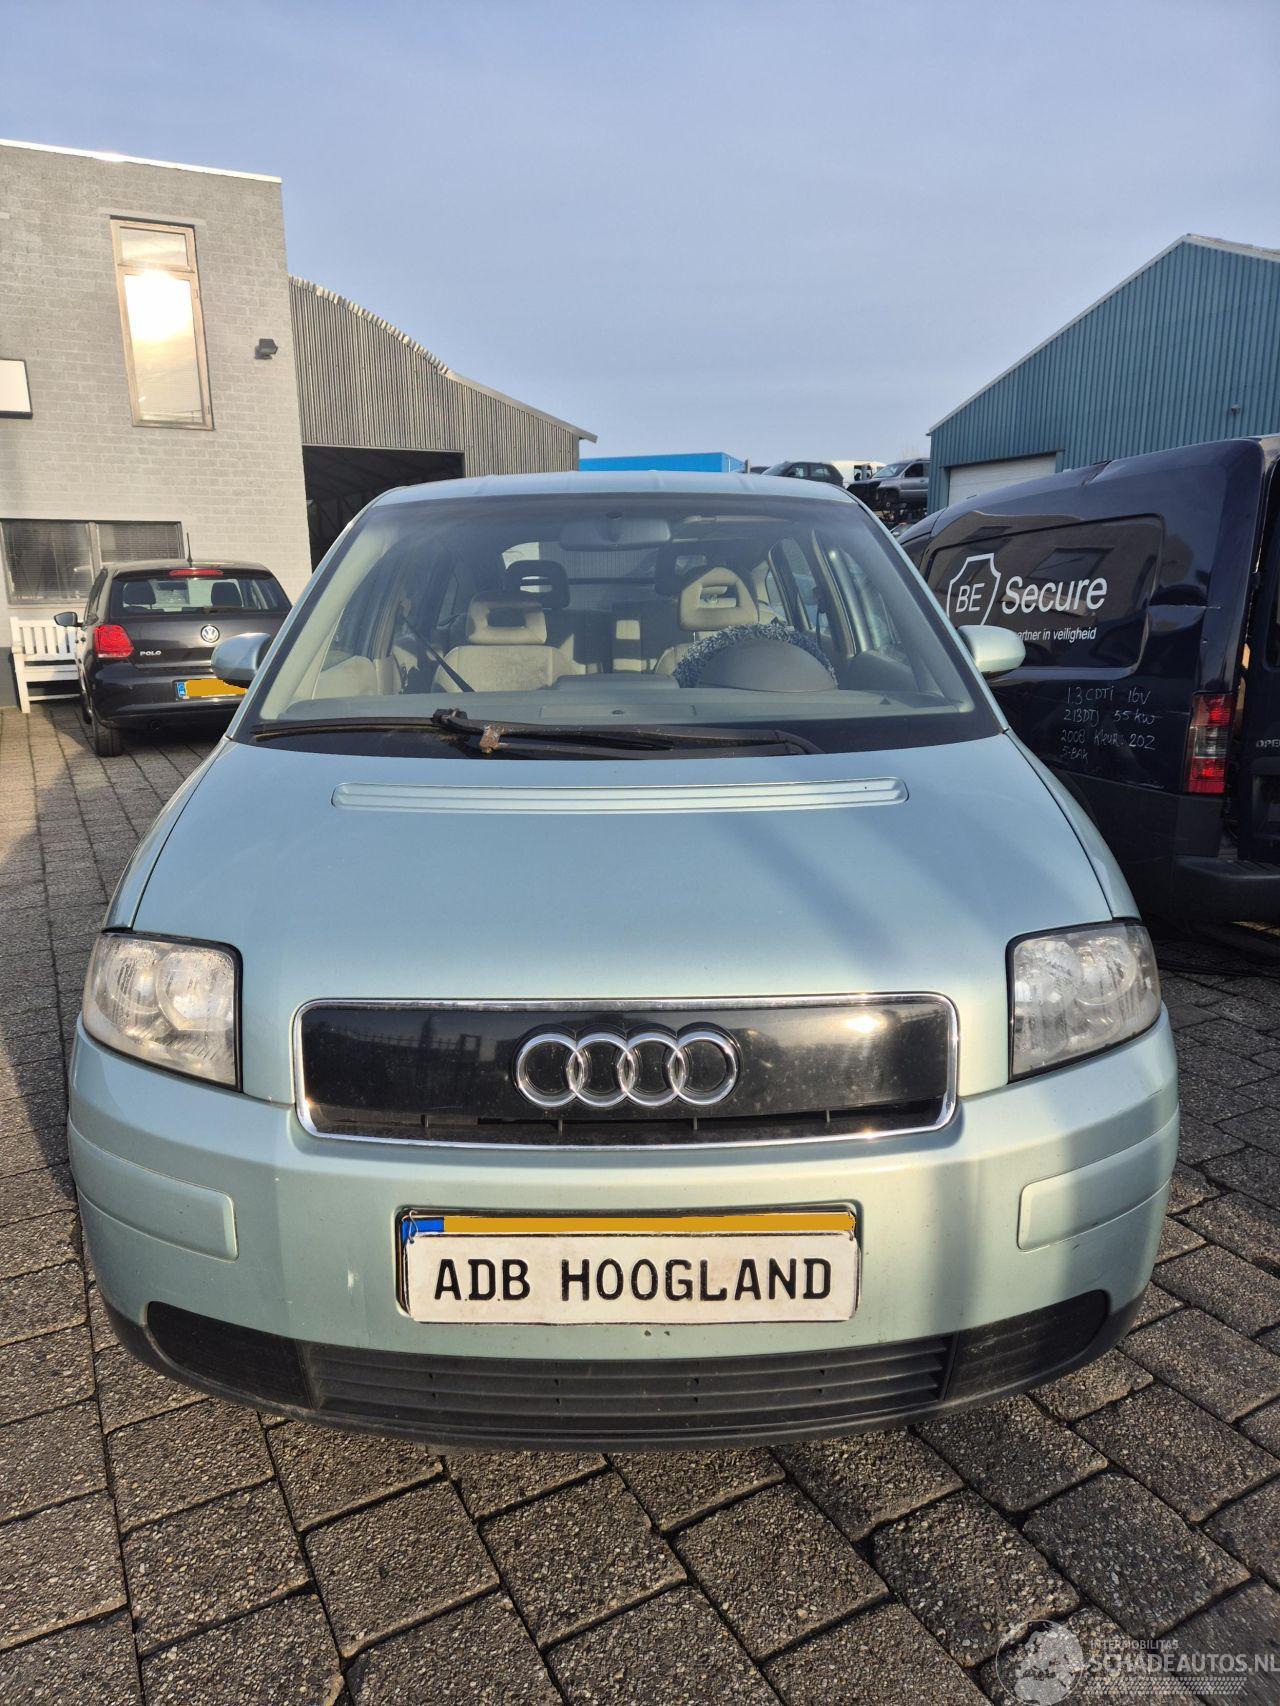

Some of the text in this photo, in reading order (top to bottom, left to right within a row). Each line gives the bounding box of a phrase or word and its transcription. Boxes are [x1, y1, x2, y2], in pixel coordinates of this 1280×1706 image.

[956, 576, 1107, 614] BE Secure
[1017, 626, 1097, 643] artner in veiligheid
[1061, 729, 1086, 744] 2008
[1256, 739, 1280, 748] OPE
[561, 1258, 832, 1302] HOOGLAND
